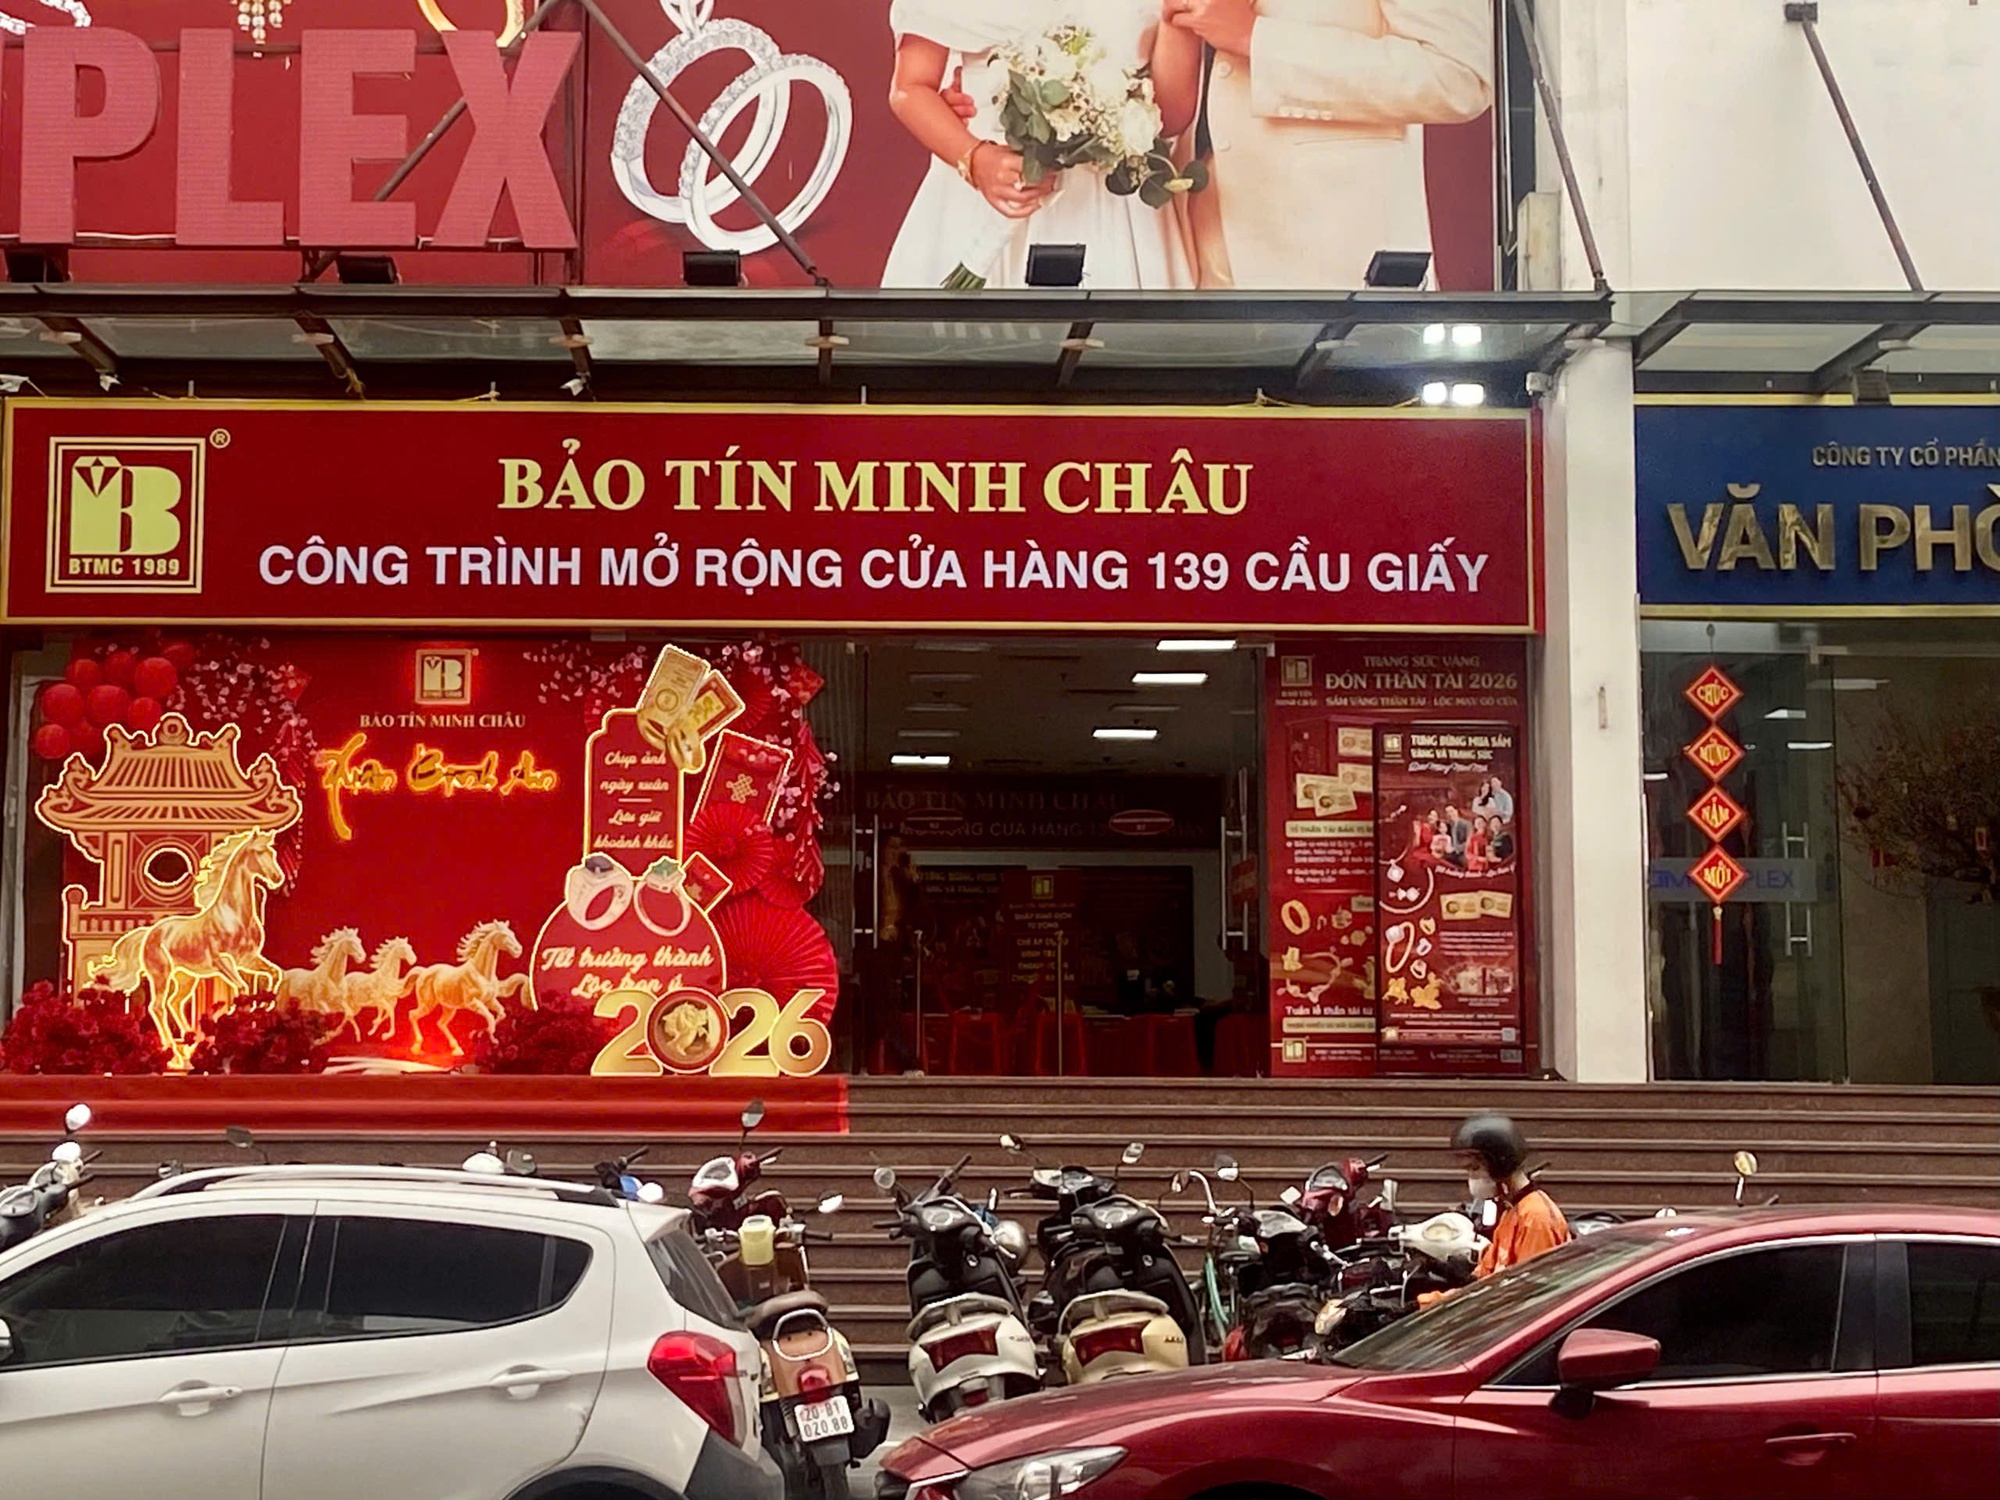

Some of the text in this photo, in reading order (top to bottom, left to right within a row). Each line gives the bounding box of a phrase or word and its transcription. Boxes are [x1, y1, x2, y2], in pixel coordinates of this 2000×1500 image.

[20, 28, 581, 248] PLEX
[1812, 441, 1870, 466] CÔNG
[1876, 447, 1904, 466] TY
[1910, 437, 1939, 466] CỔ
[498, 439, 1252, 515] BẢO TÍN MINH CHÂU
[1667, 483, 1835, 570] VĂN
[69, 558, 180, 575] BTMC 1989
[259, 532, 1488, 595] CÔNG TRÌNH MỞ RỘNG CỬA HÀNG 139 CẦU GIẤY
[1364, 656, 1409, 668] TRANG
[1325, 671, 1367, 689] ĐÓN
[1375, 668, 1427, 689] THẦN
[1469, 673, 1518, 689] 2026
[430, 714, 475, 727] MINH
[653, 945, 715, 967] thành
